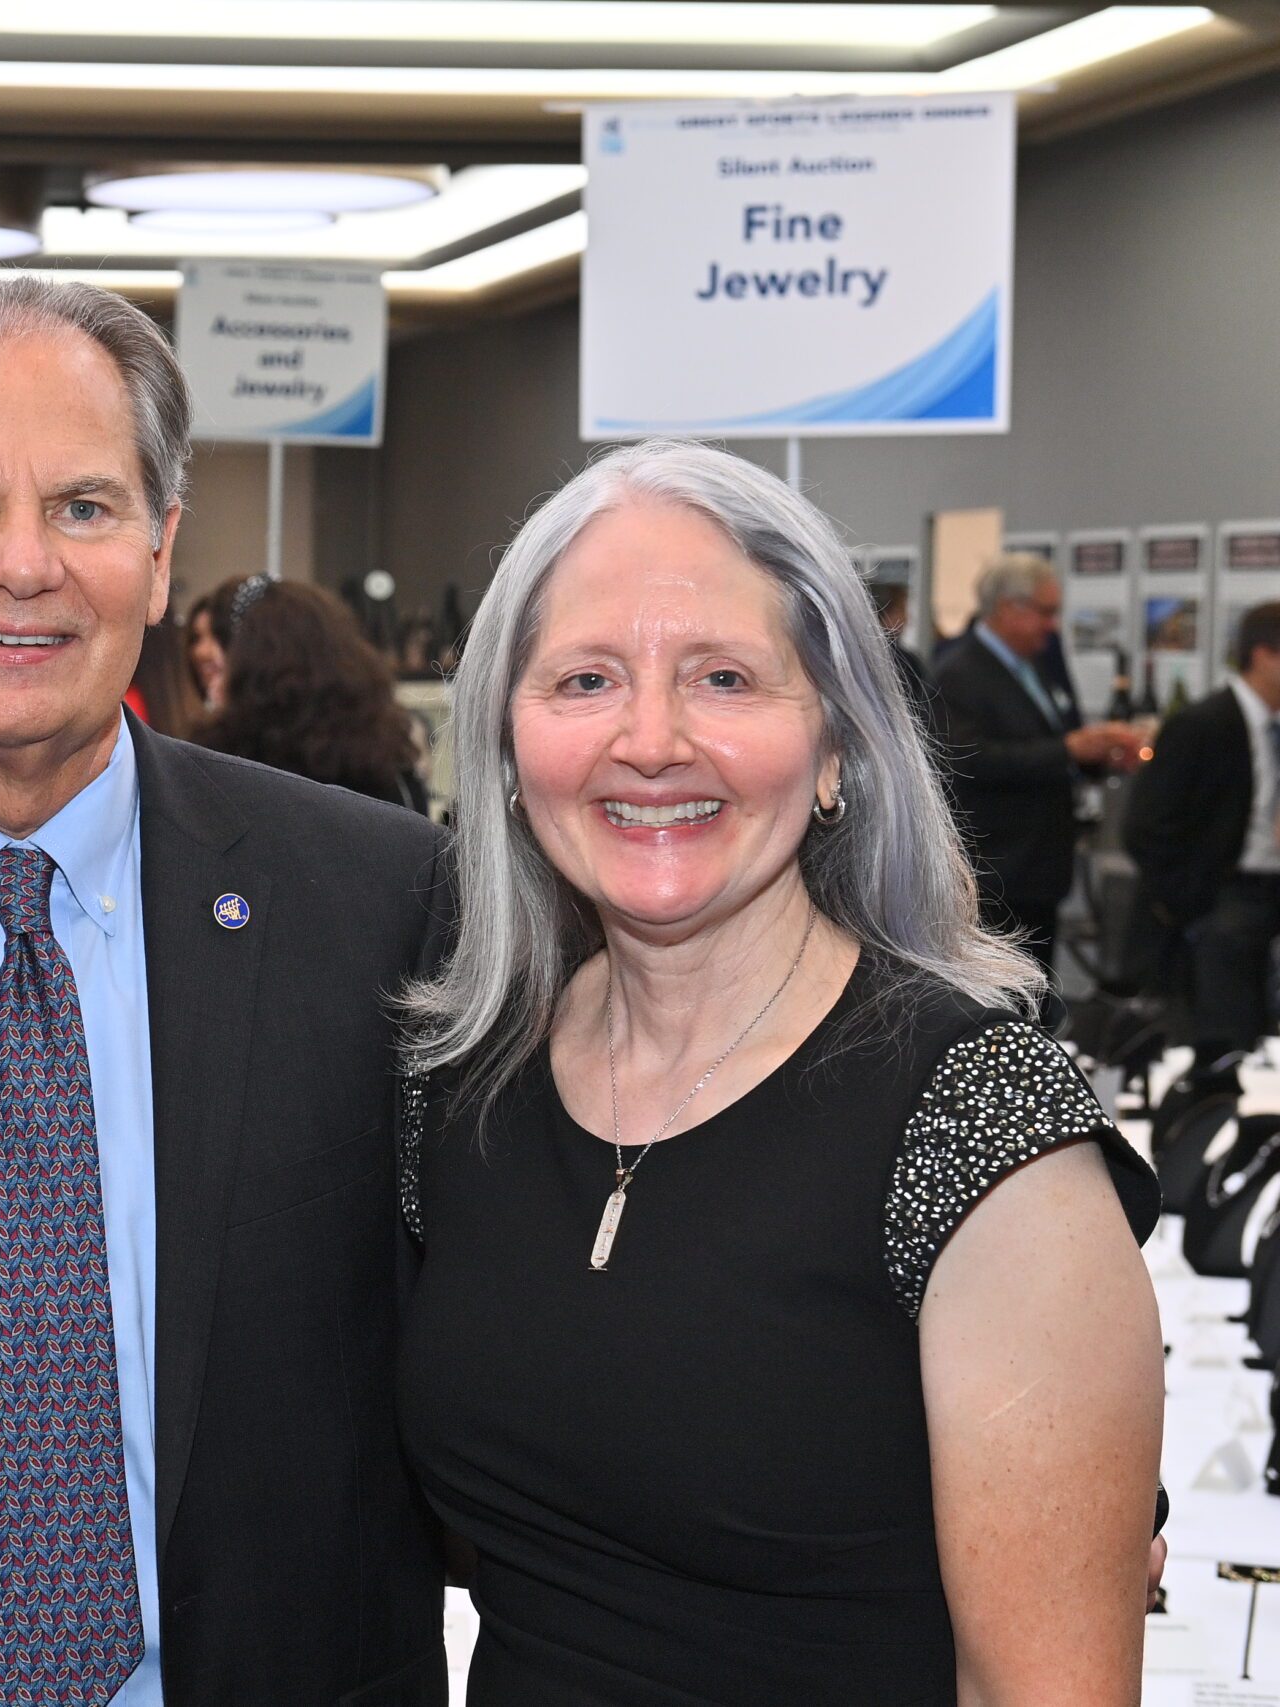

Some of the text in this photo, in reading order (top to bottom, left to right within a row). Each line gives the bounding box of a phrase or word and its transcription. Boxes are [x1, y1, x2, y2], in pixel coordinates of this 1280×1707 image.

[718, 155, 876, 178] Silent Auction
[742, 204, 844, 242] Fine
[696, 257, 888, 308] Jewelry
[212, 316, 352, 342] Accessories
[260, 349, 303, 370] and
[233, 375, 325, 403] Jewelry
